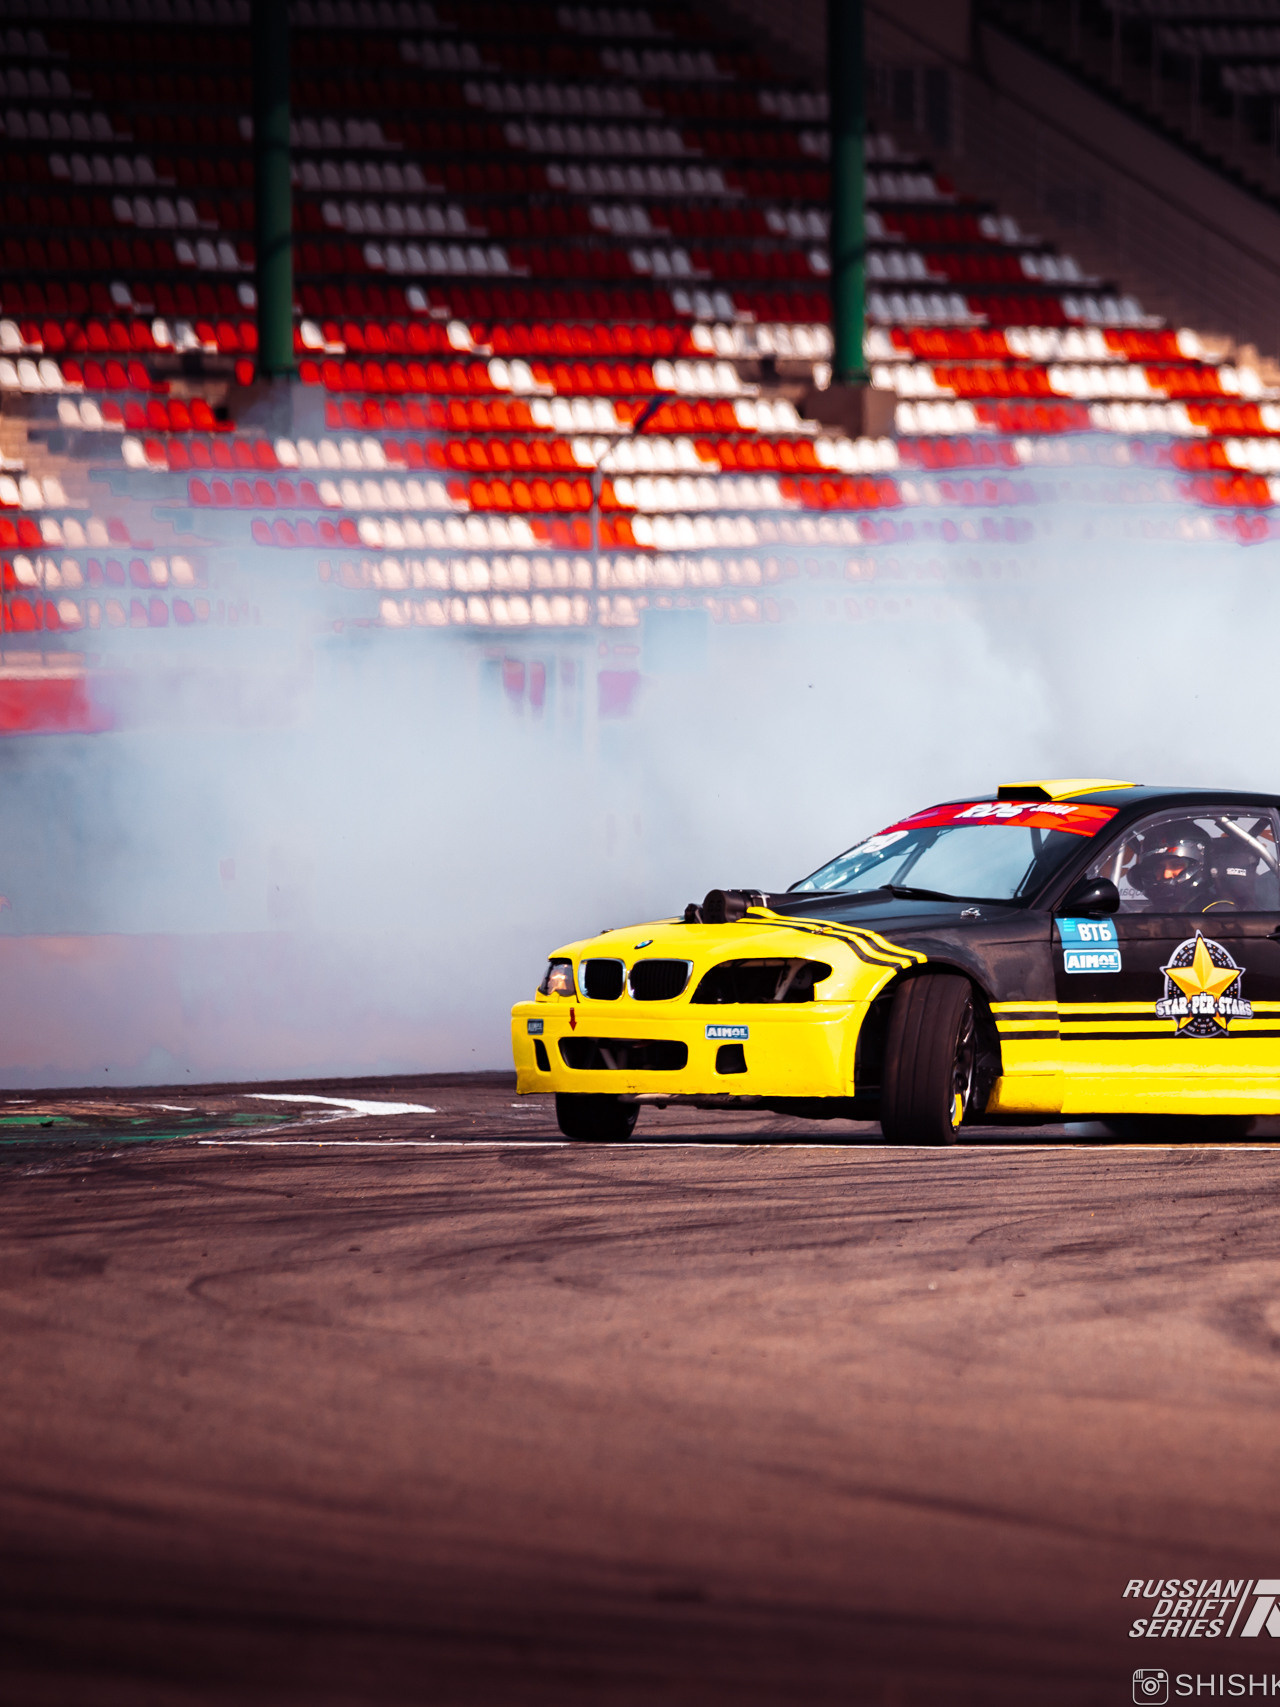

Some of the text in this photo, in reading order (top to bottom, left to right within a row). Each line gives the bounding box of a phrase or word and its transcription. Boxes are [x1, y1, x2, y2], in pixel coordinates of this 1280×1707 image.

[1077, 923, 1112, 941] ВТБ
[1068, 954, 1118, 969] AIMOL
[1157, 997, 1188, 1016] STAR
[1218, 996, 1252, 1016] STARS
[707, 1027, 748, 1038] AIMOL
